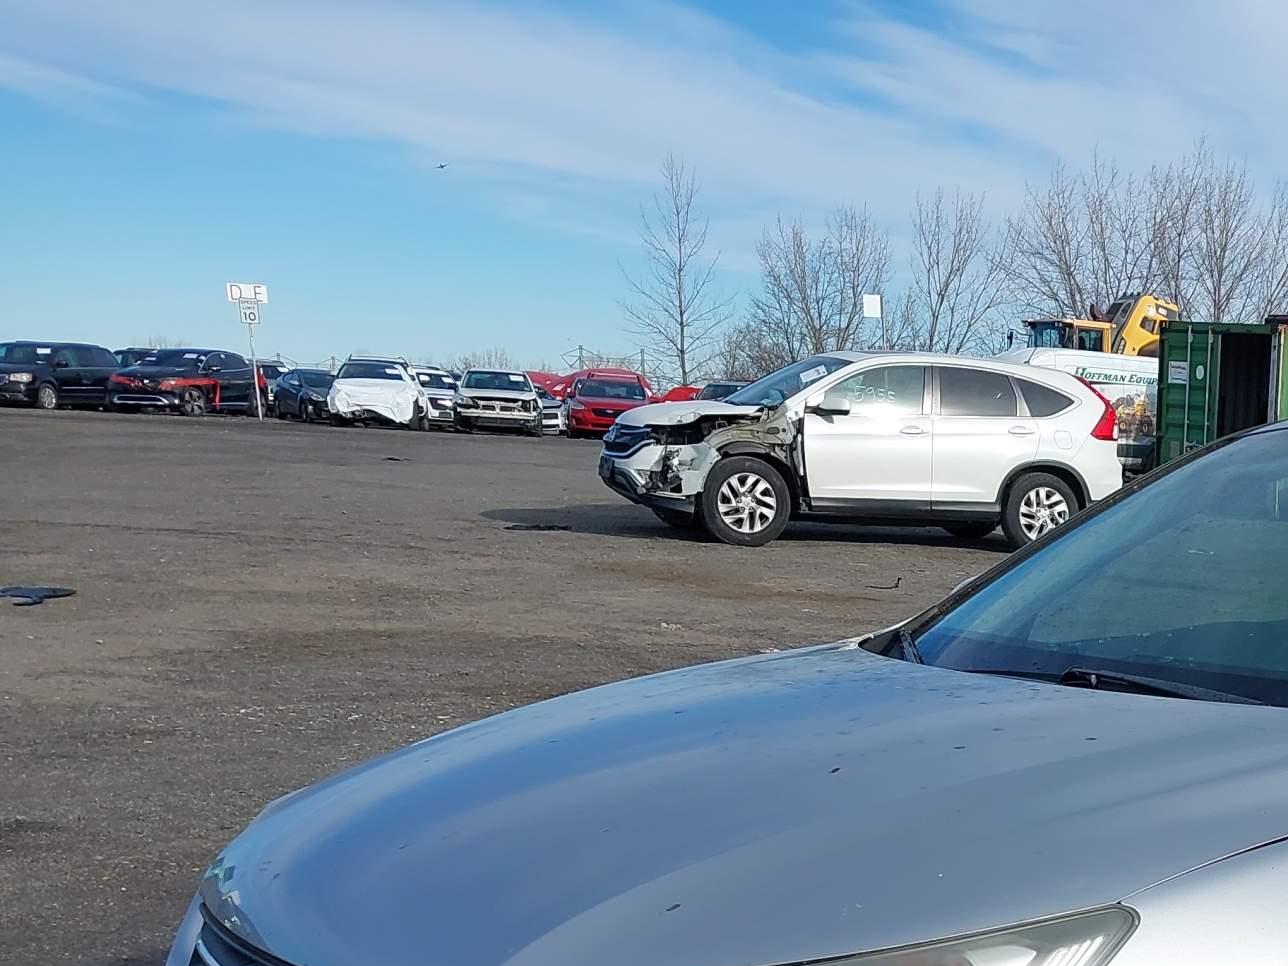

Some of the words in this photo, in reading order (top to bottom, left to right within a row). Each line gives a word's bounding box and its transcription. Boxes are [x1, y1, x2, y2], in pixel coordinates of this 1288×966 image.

[230, 284, 242, 300] D
[243, 311, 256, 321] 10
[1128, 374, 1158, 384] EQUIP
